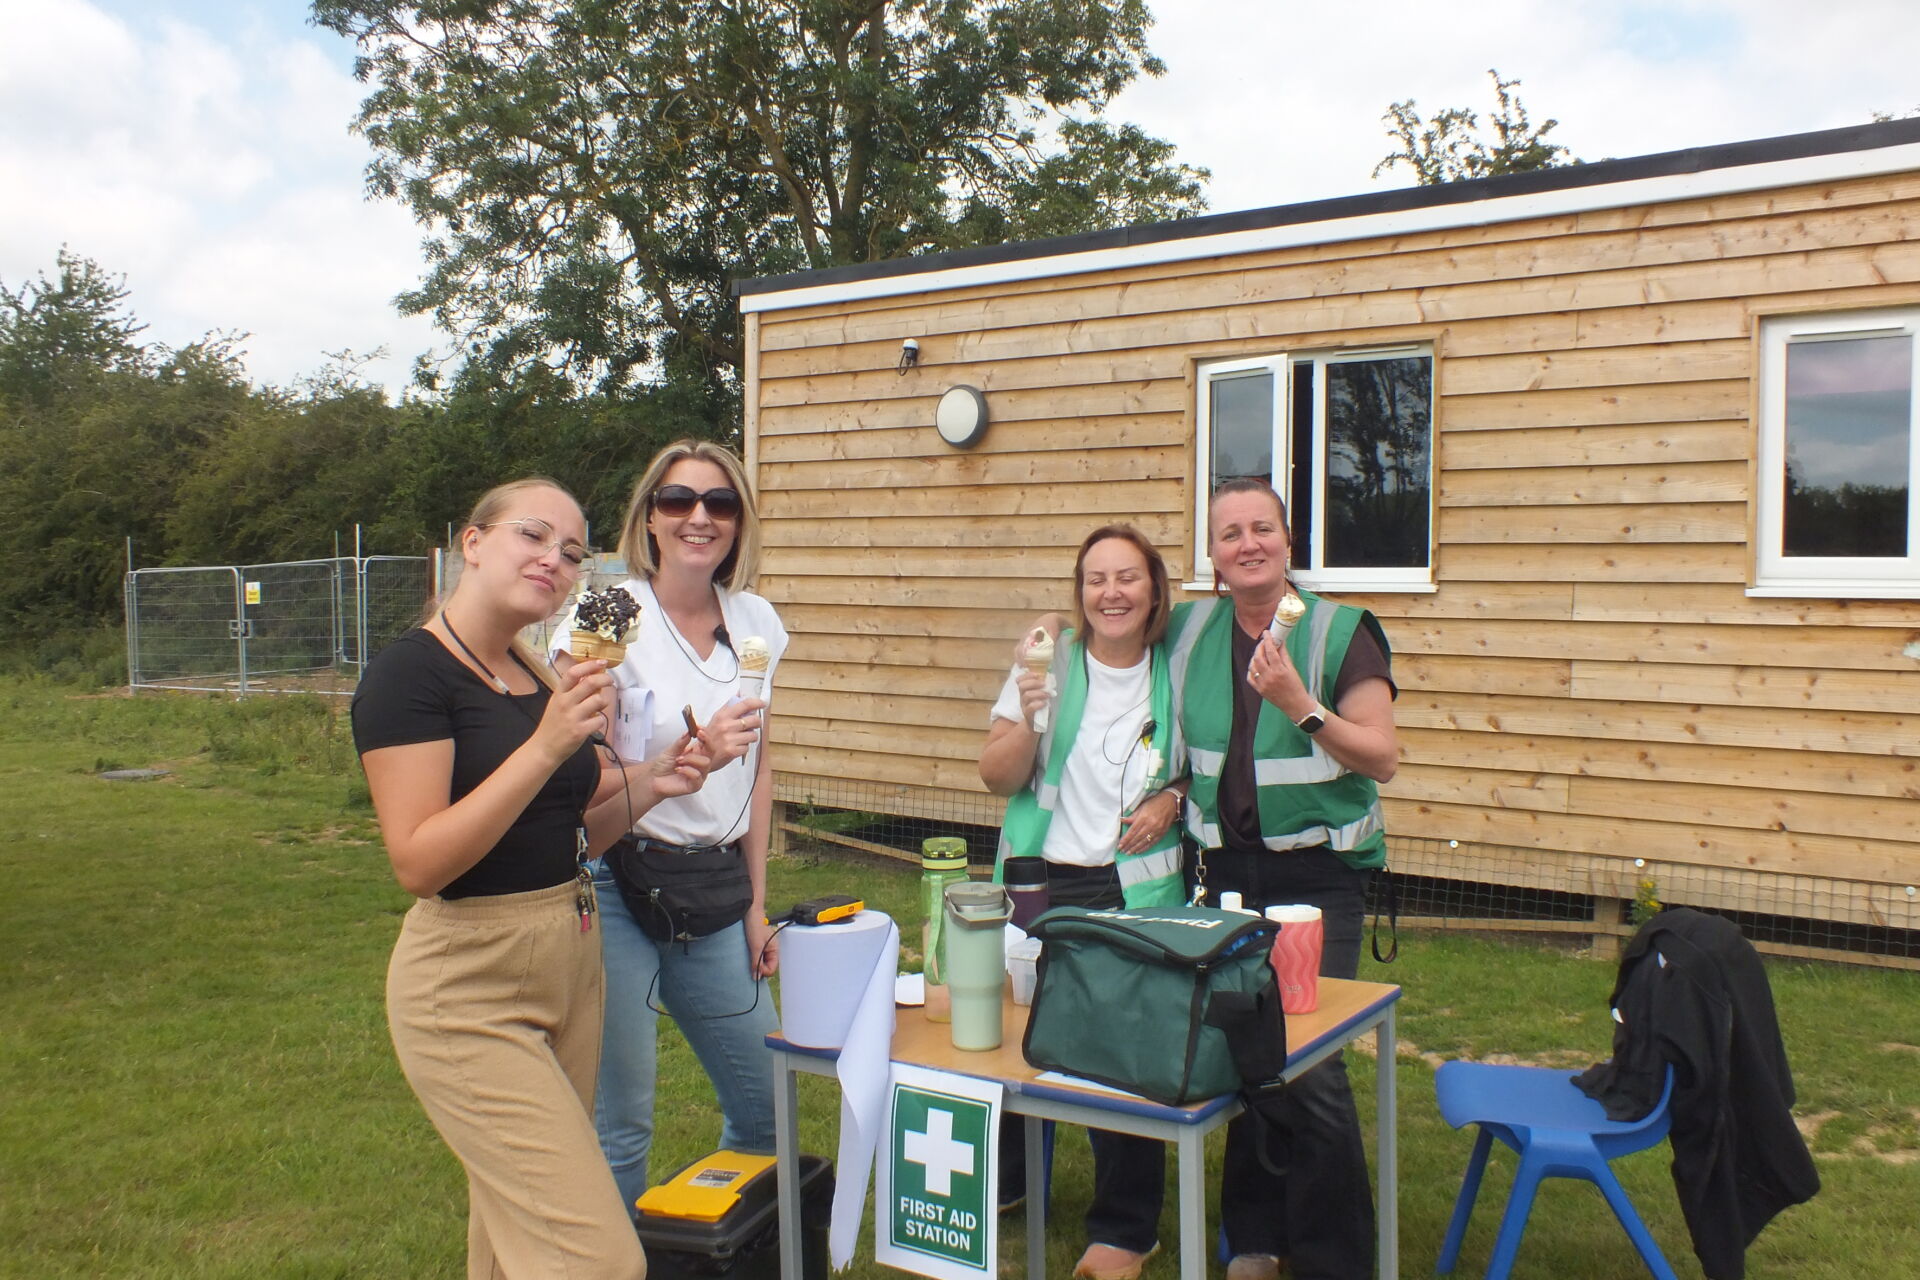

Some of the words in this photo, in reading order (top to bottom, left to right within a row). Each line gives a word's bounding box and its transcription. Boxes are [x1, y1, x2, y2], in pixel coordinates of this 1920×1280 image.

[900, 1196, 945, 1222] FIRST
[949, 1209, 977, 1230] AID
[905, 1219, 970, 1251] STATION
